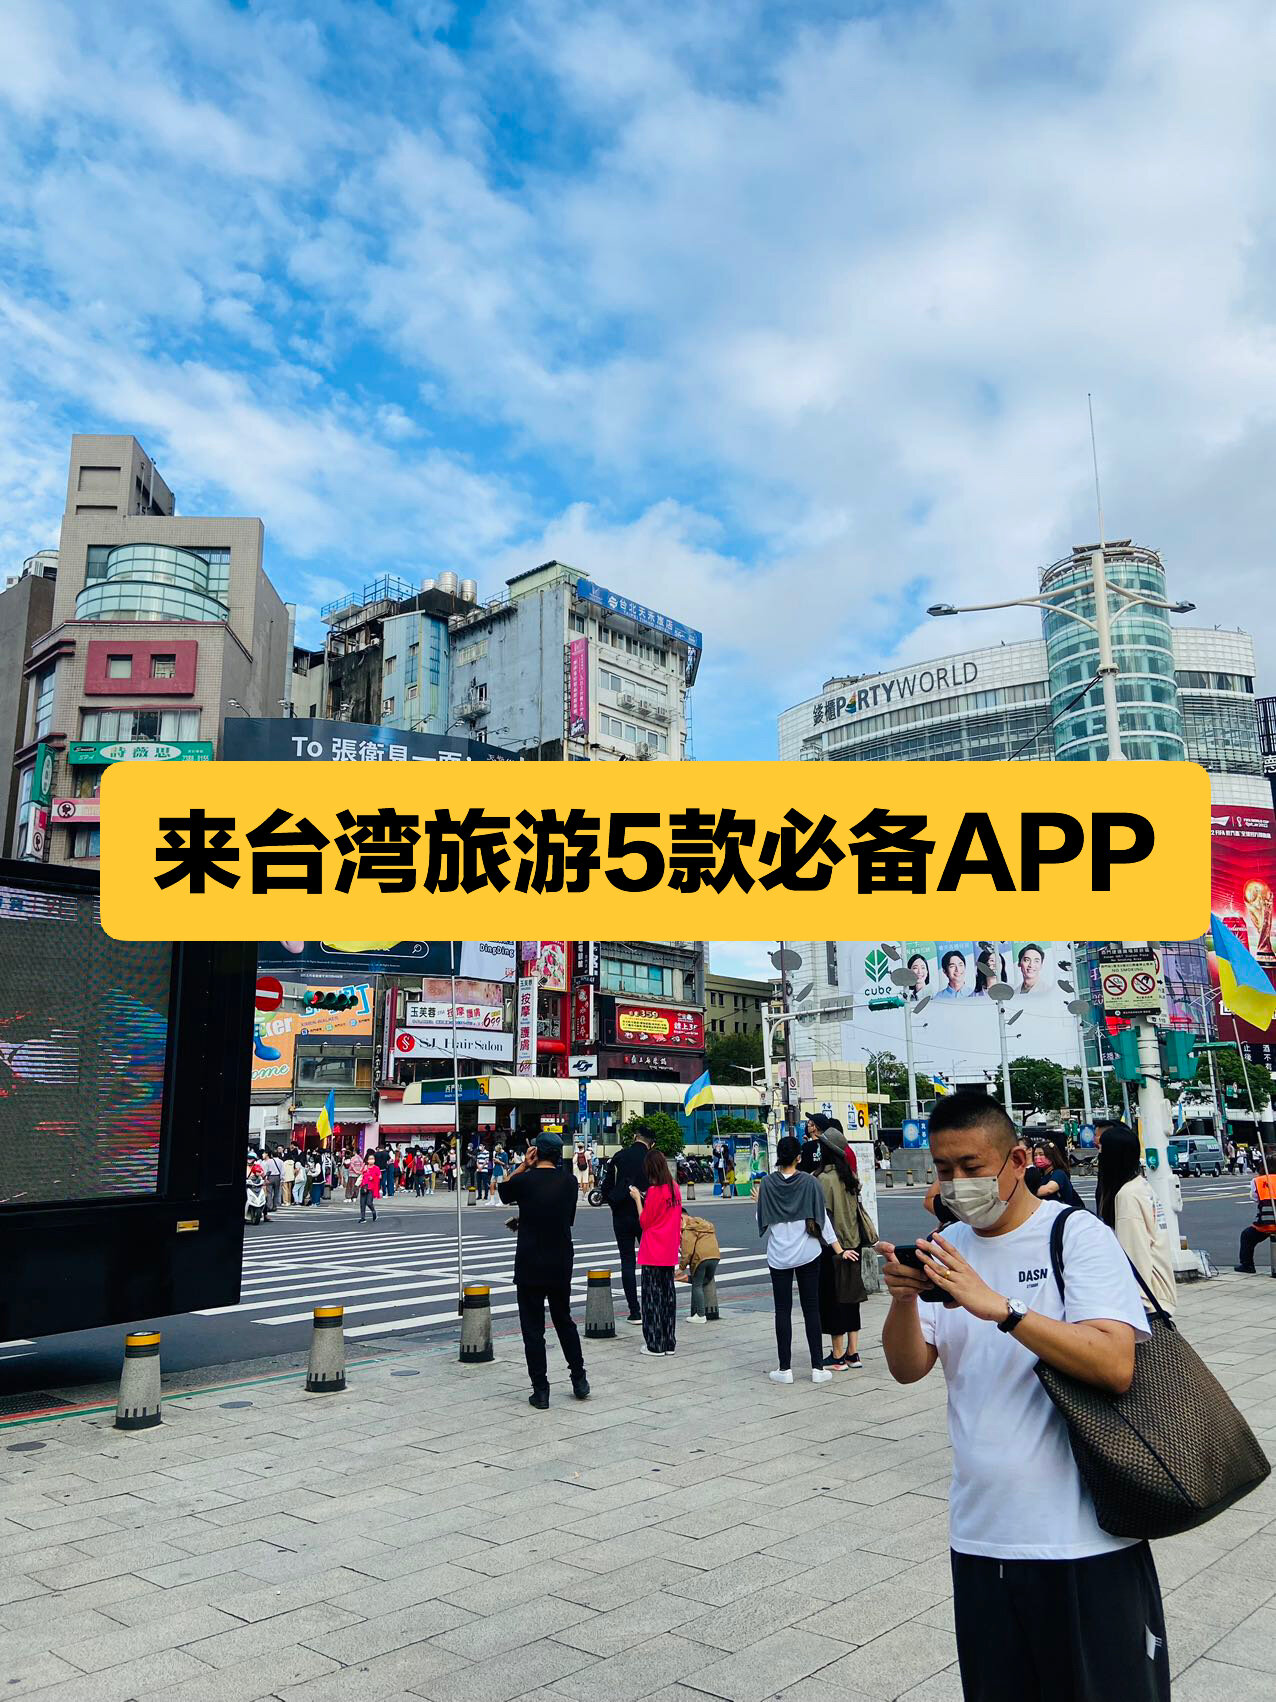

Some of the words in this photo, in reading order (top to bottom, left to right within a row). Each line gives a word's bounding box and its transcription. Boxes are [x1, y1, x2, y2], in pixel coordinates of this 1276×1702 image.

[291, 736, 323, 758] To
[479, 944, 515, 959] DingDing
[864, 985, 892, 997] cube
[410, 1006, 437, 1018] 玉芙蓉
[483, 1012, 501, 1028] 699
[444, 1038, 473, 1050] Hair
[474, 1039, 503, 1052] Salon
[479, 1082, 485, 1096] 6
[857, 1109, 865, 1128] 6
[1018, 1268, 1048, 1283] DASN
